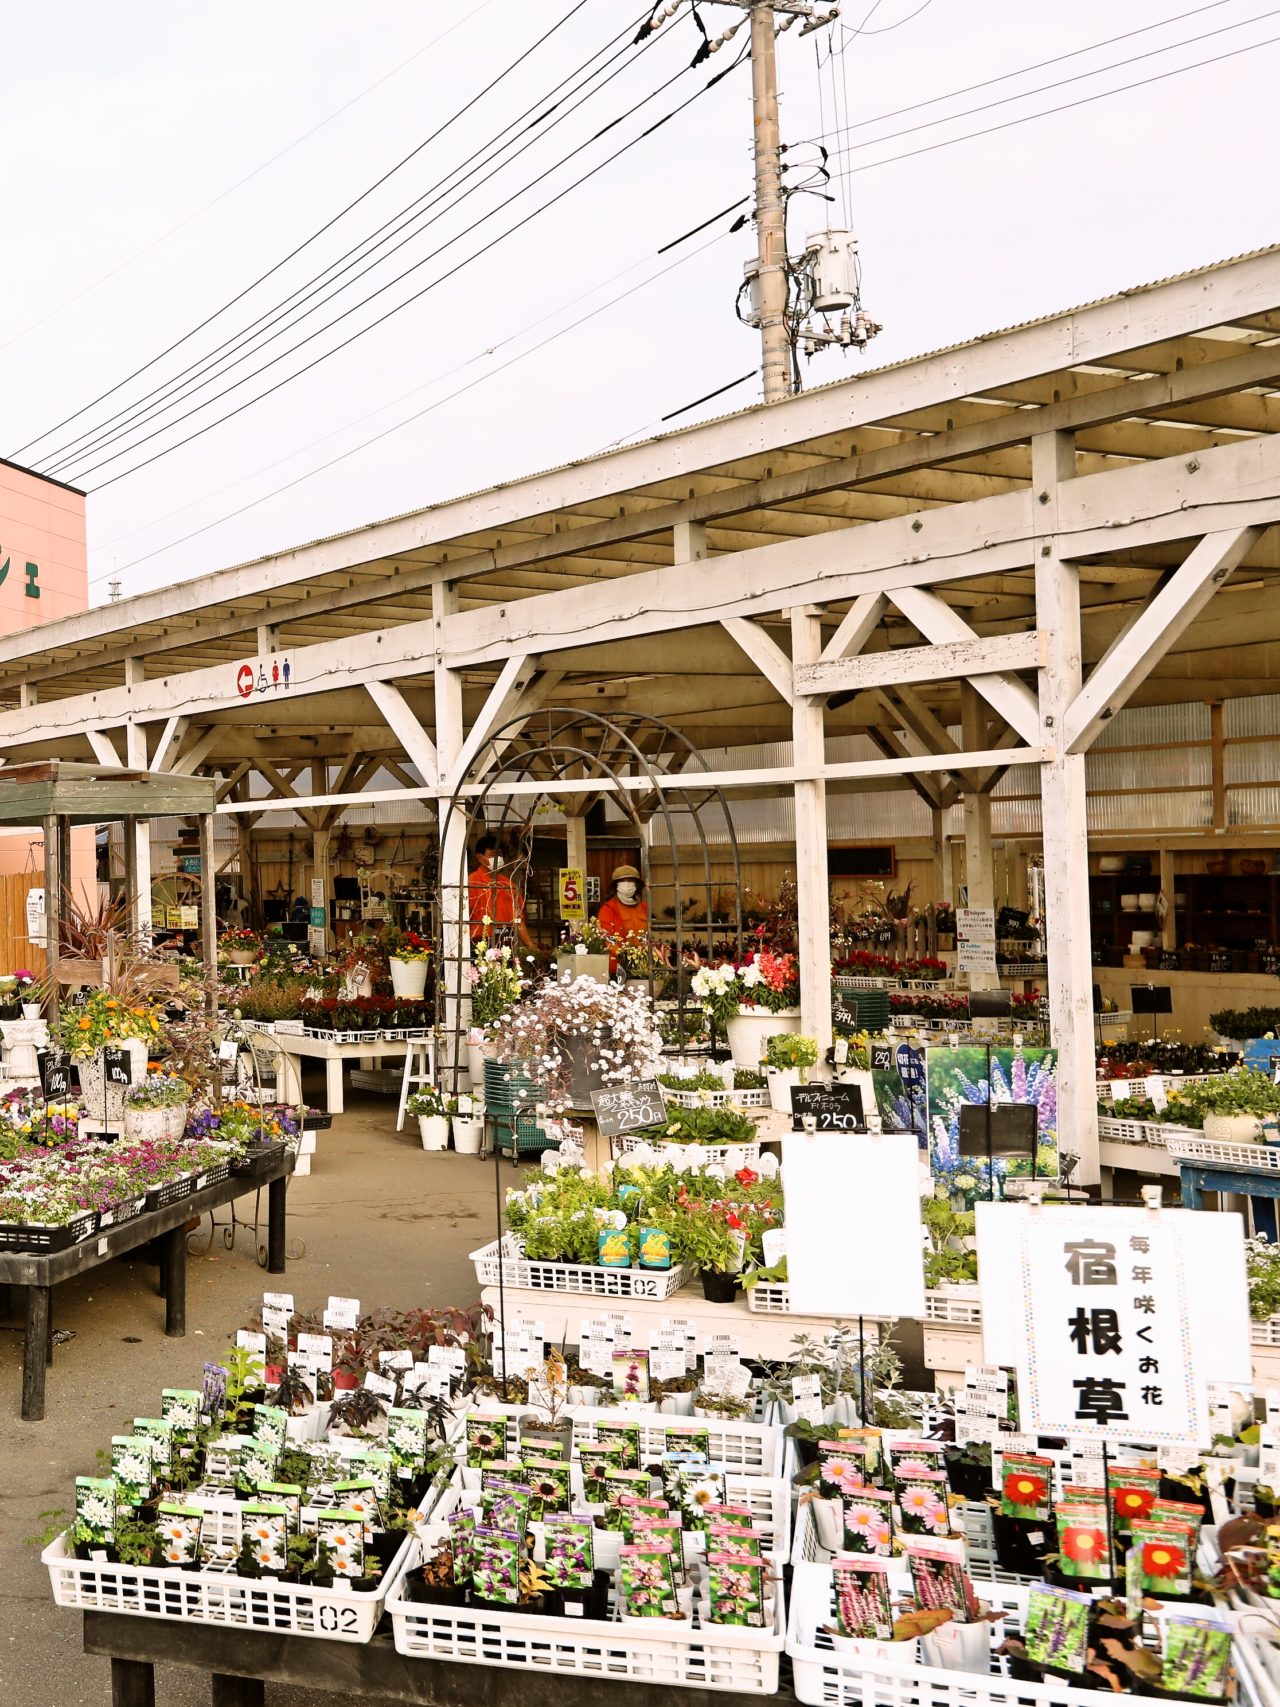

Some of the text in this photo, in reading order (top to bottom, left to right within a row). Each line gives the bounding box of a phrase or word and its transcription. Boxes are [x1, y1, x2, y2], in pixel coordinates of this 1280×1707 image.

[633, 1279, 658, 1296] 02
[1063, 1238, 1129, 1425] 宿根草
[1129, 1234, 1163, 1406] 毎年咲くお花
[319, 1604, 359, 1634] 02
